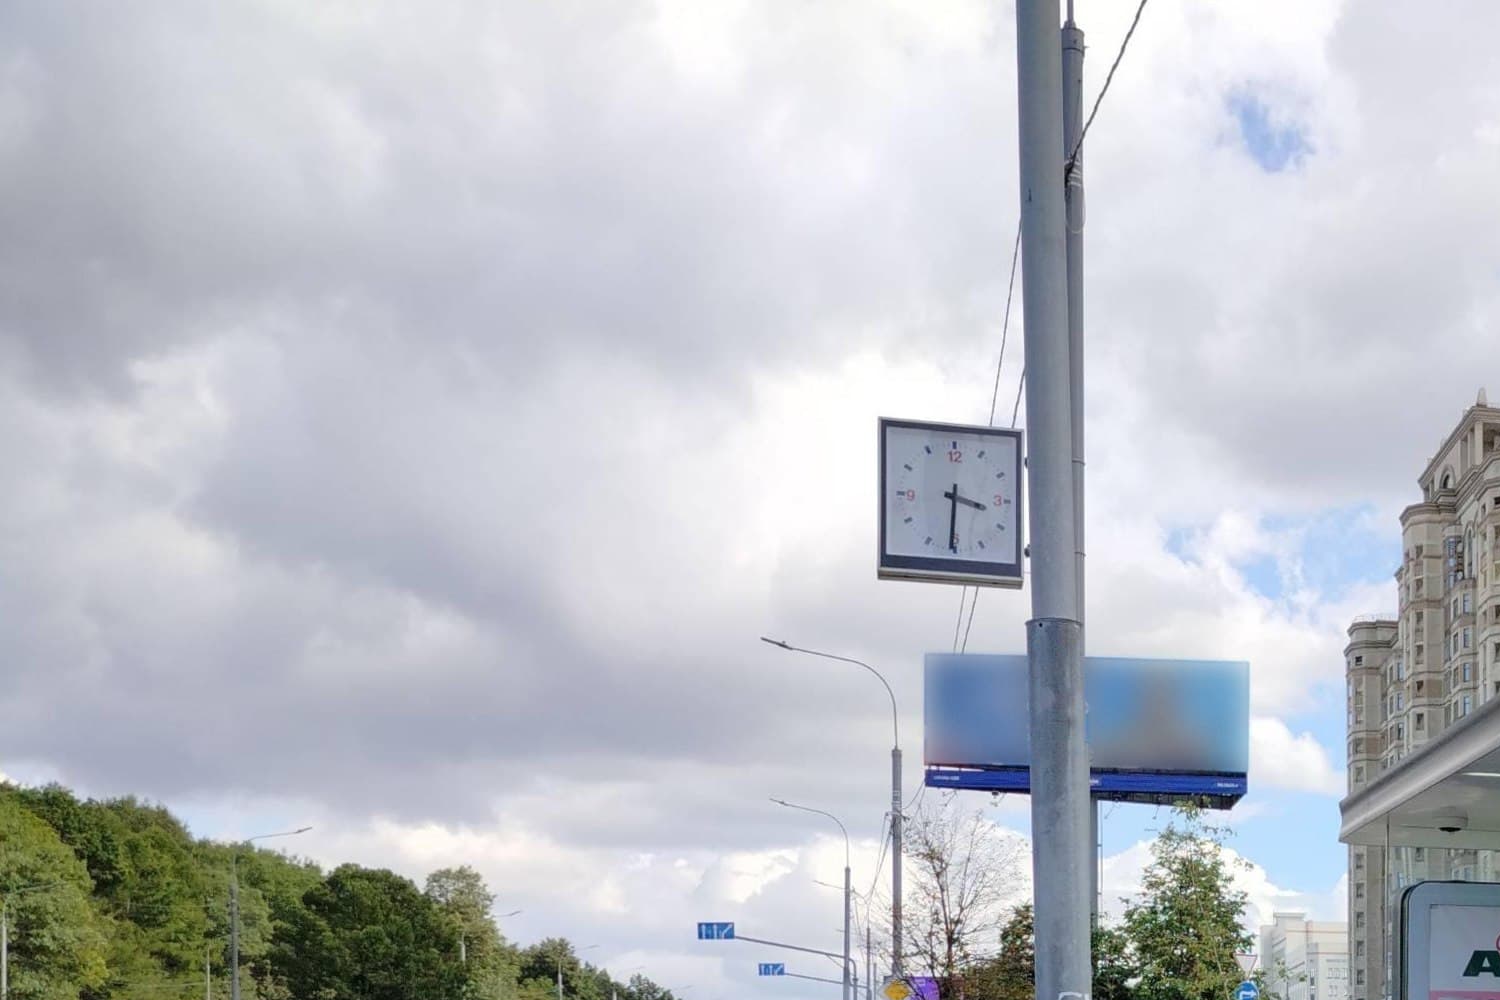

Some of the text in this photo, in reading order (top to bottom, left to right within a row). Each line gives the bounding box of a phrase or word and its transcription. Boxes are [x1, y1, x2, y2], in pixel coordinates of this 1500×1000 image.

[947, 451, 962, 463] 12
[907, 490, 915, 500] 9
[994, 495, 1002, 506] 3
